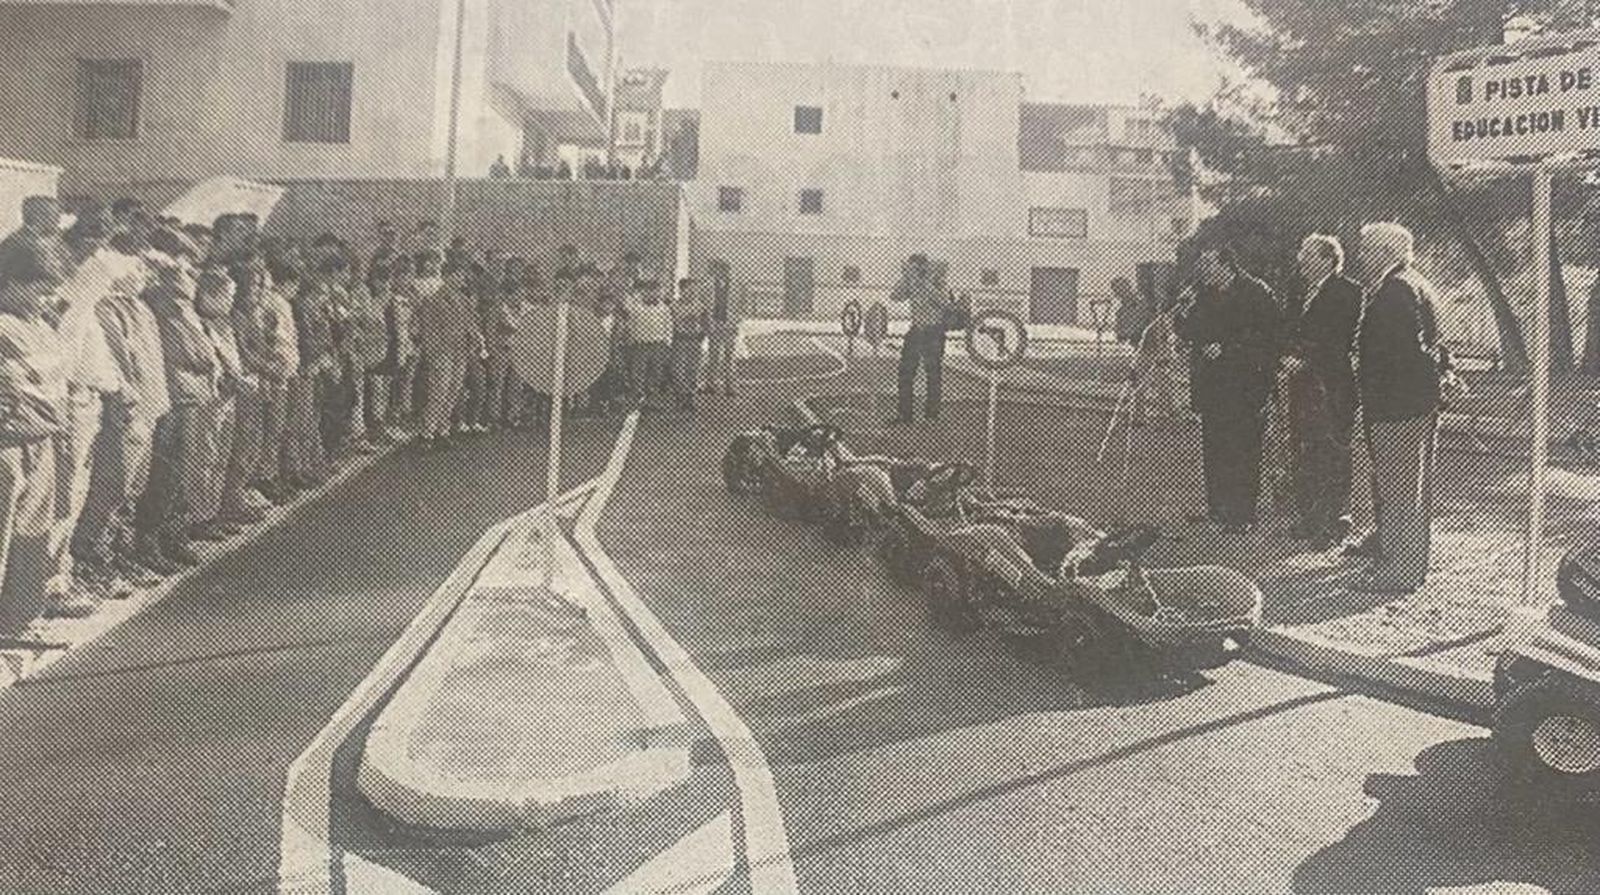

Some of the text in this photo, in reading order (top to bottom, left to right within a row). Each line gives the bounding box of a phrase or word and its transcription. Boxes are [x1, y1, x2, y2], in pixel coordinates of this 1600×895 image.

[1486, 67, 1592, 101] PISTA DE
[1452, 109, 1564, 142] EDUCACION
